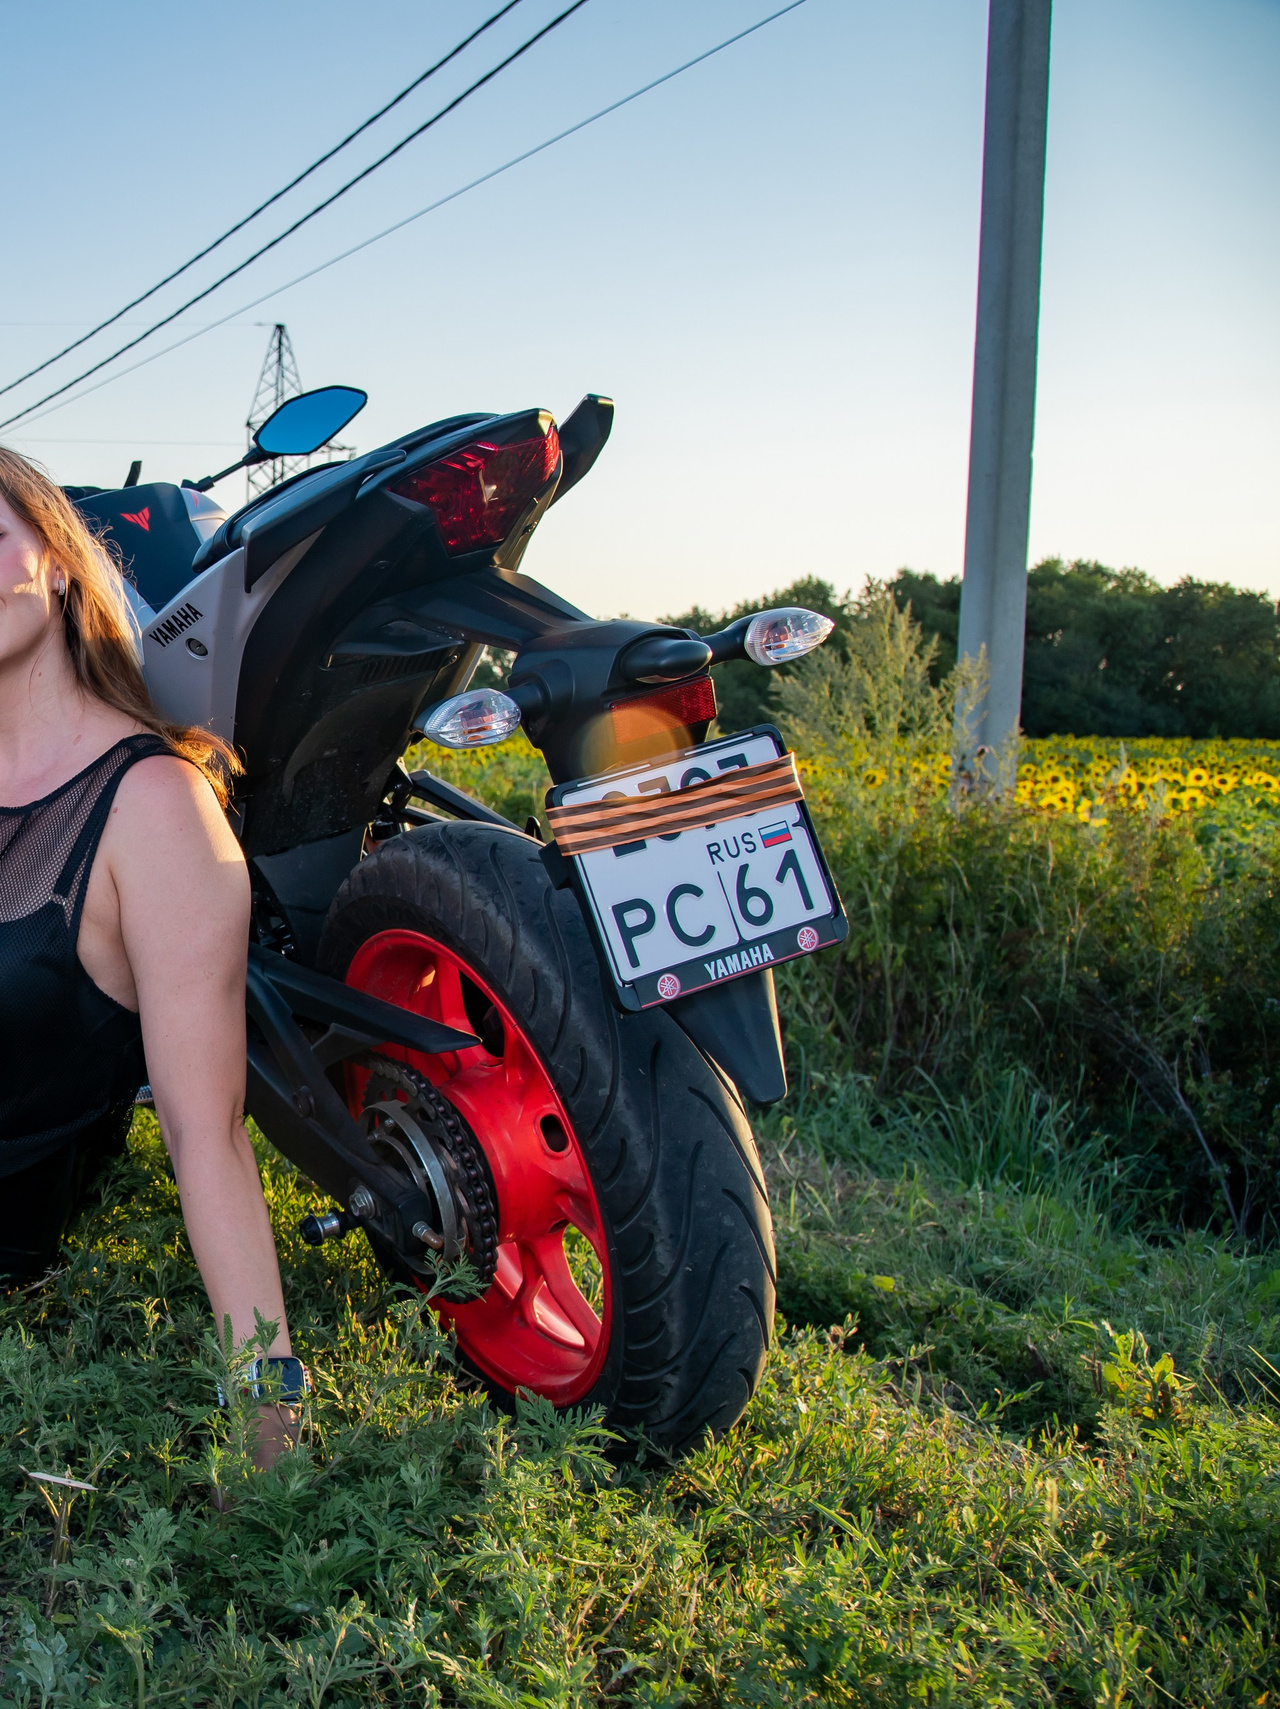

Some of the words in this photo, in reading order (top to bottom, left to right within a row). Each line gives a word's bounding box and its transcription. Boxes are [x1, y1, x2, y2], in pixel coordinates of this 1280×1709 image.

[149, 603, 203, 648] YAMAHA
[706, 832, 757, 865] RUS
[611, 884, 716, 968] PC
[736, 849, 814, 927] 61
[704, 943, 774, 981] YAMAHA
